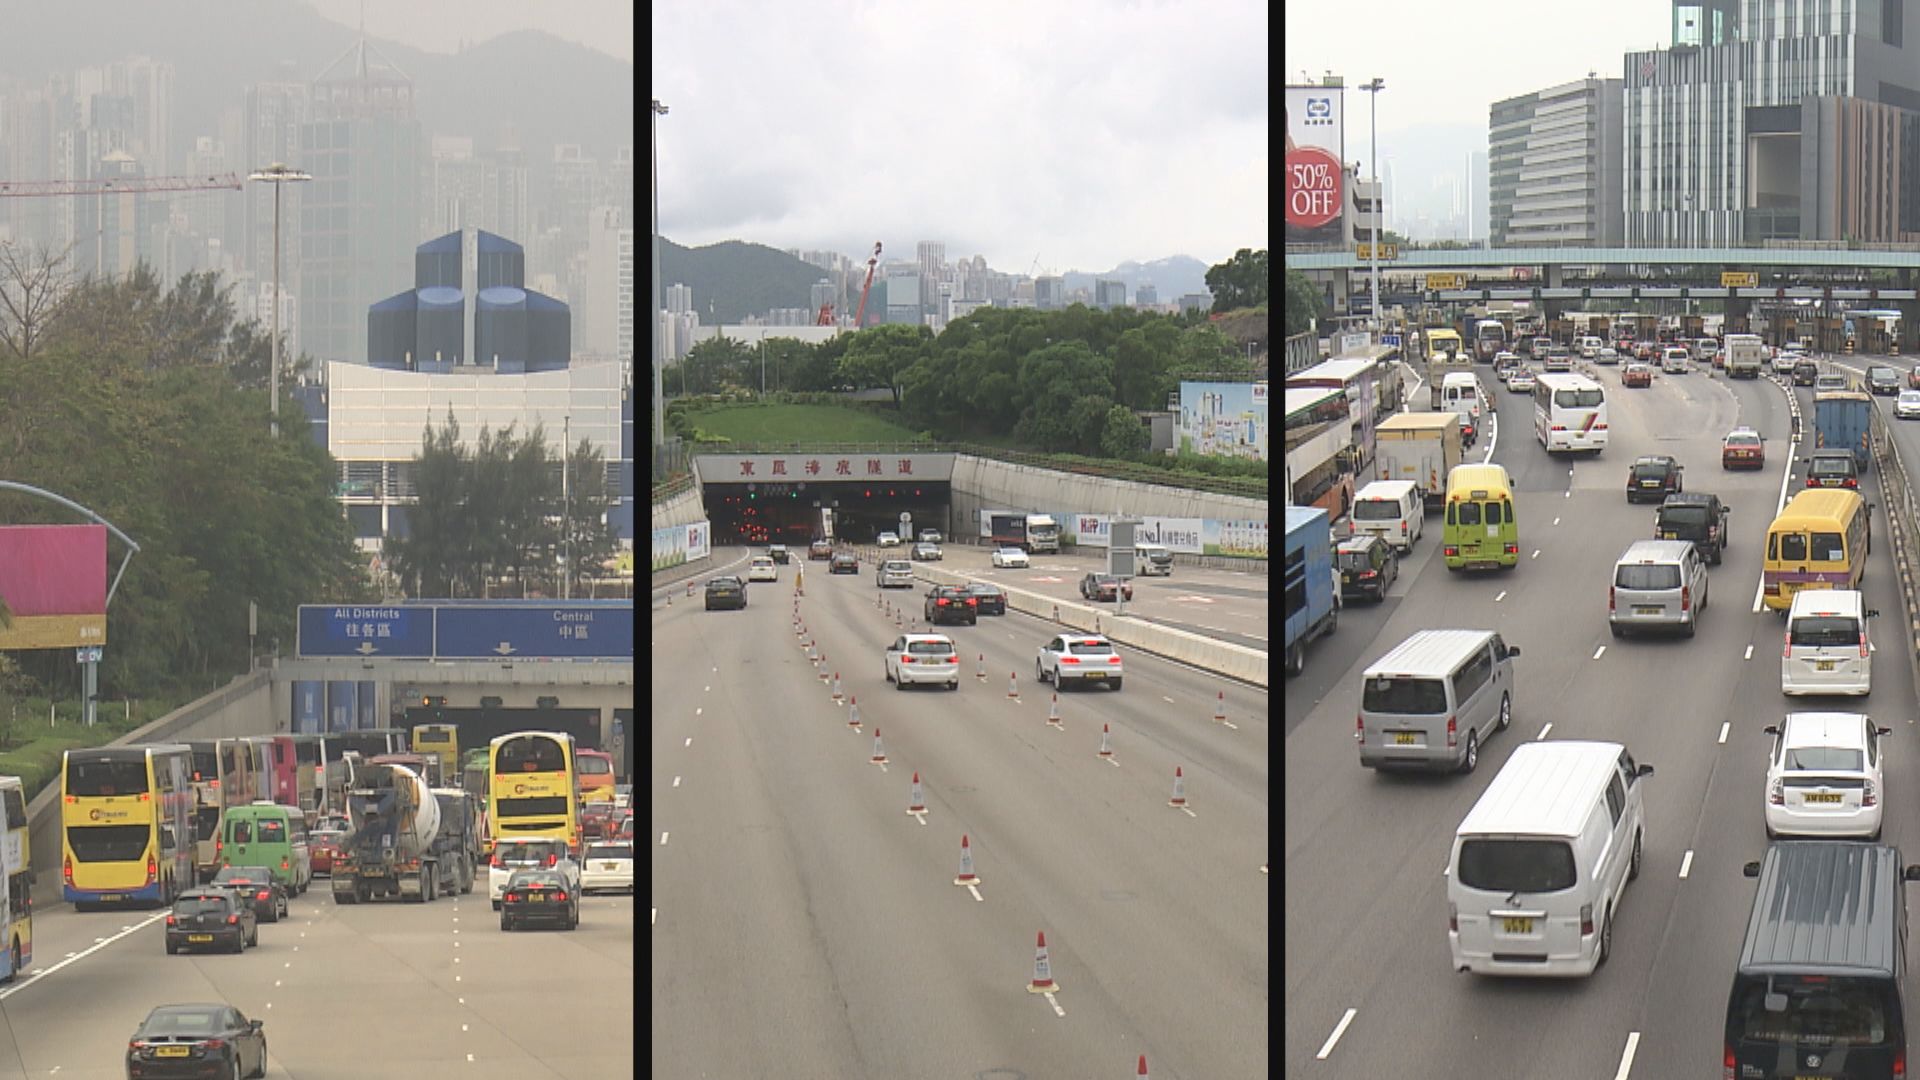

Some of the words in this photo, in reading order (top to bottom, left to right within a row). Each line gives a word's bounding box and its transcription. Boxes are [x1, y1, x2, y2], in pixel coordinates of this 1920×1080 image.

[1292, 164, 1333, 189] 50%
[335, 607, 350, 619] All
[353, 607, 400, 620] Districts
[553, 609, 593, 622] Central
[560, 624, 589, 640] 中區
